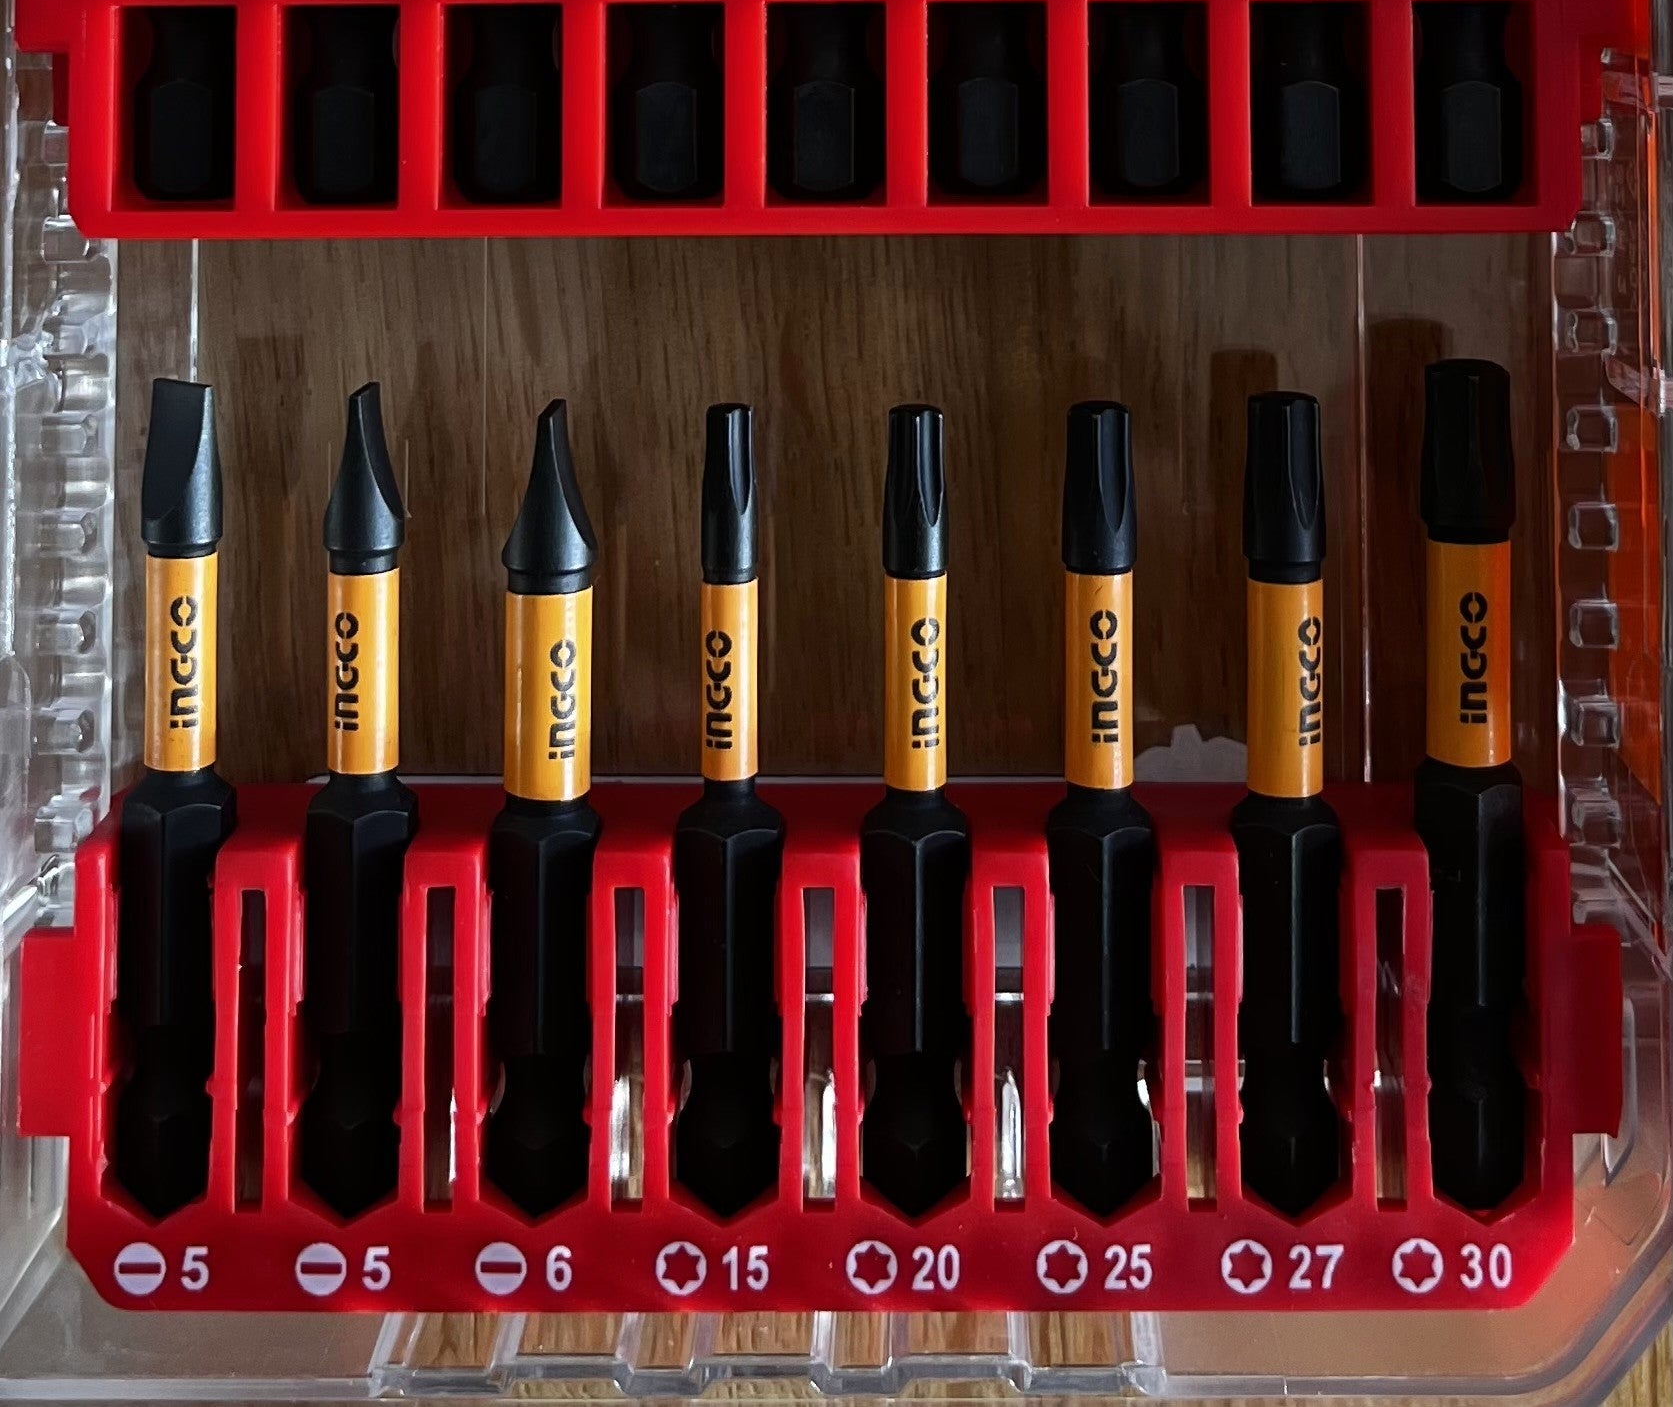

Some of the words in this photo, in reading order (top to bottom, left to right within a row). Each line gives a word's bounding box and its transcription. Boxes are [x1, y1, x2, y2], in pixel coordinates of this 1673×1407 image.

[181, 1246, 209, 1290] 5
[363, 1246, 391, 1290] 5
[546, 1245, 572, 1291] 6
[722, 1245, 769, 1291] 15
[912, 1244, 960, 1291] 20
[1104, 1243, 1153, 1290] 25
[1289, 1244, 1345, 1290] 27
[1460, 1243, 1513, 1289] 30
